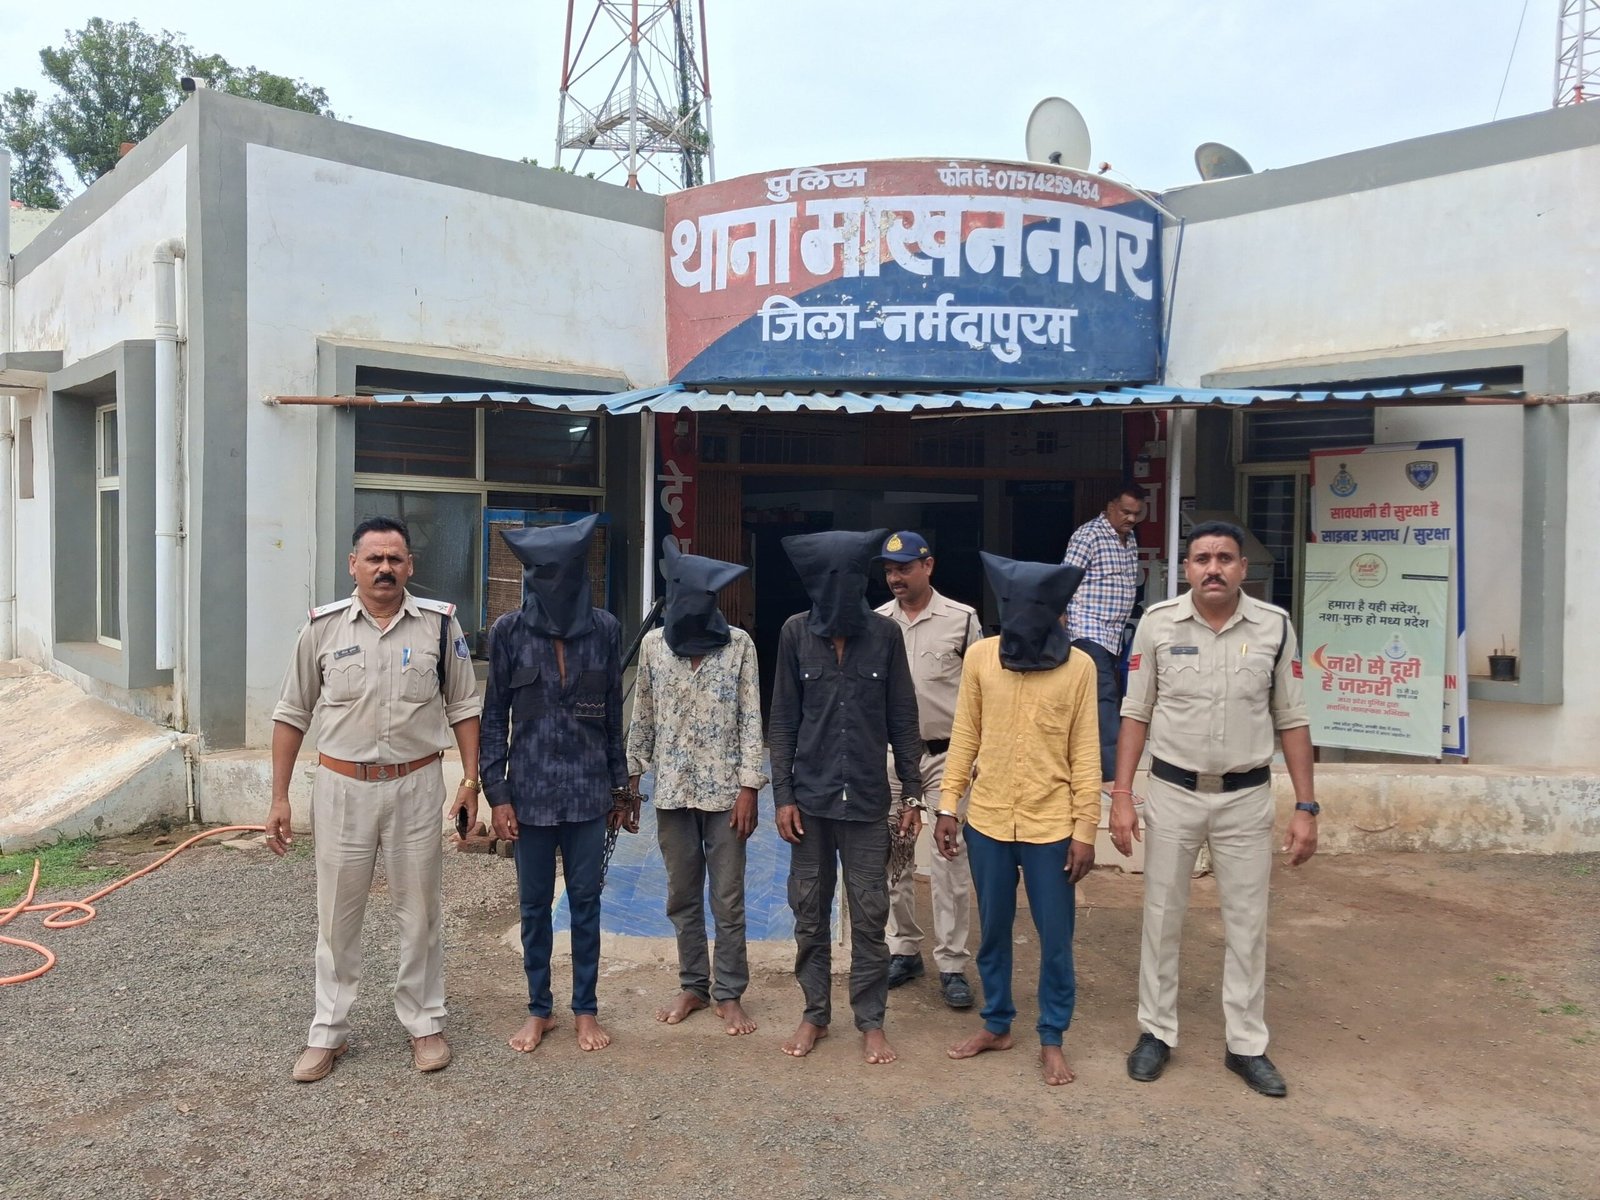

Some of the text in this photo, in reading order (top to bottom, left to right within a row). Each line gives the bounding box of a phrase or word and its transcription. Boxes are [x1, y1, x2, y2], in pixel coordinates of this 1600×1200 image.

[766, 167, 867, 200] पुलिस
[670, 202, 798, 293] थाना
[1330, 501, 1440, 522] सावधानी ही सुरक्षा है
[1321, 530, 1359, 543] साइबर
[1361, 529, 1399, 542] अपराध
[1413, 528, 1451, 545] सुरक्षा
[1328, 600, 1355, 611] हमारा
[1358, 599, 1365, 612] है
[1368, 600, 1387, 613] यही
[1366, 613, 1377, 625] हो
[1380, 616, 1401, 626] मध्य
[1404, 616, 1429, 628] प्रदेश
[1326, 653, 1421, 684] नशे से दूरी
[1321, 671, 1334, 691] है
